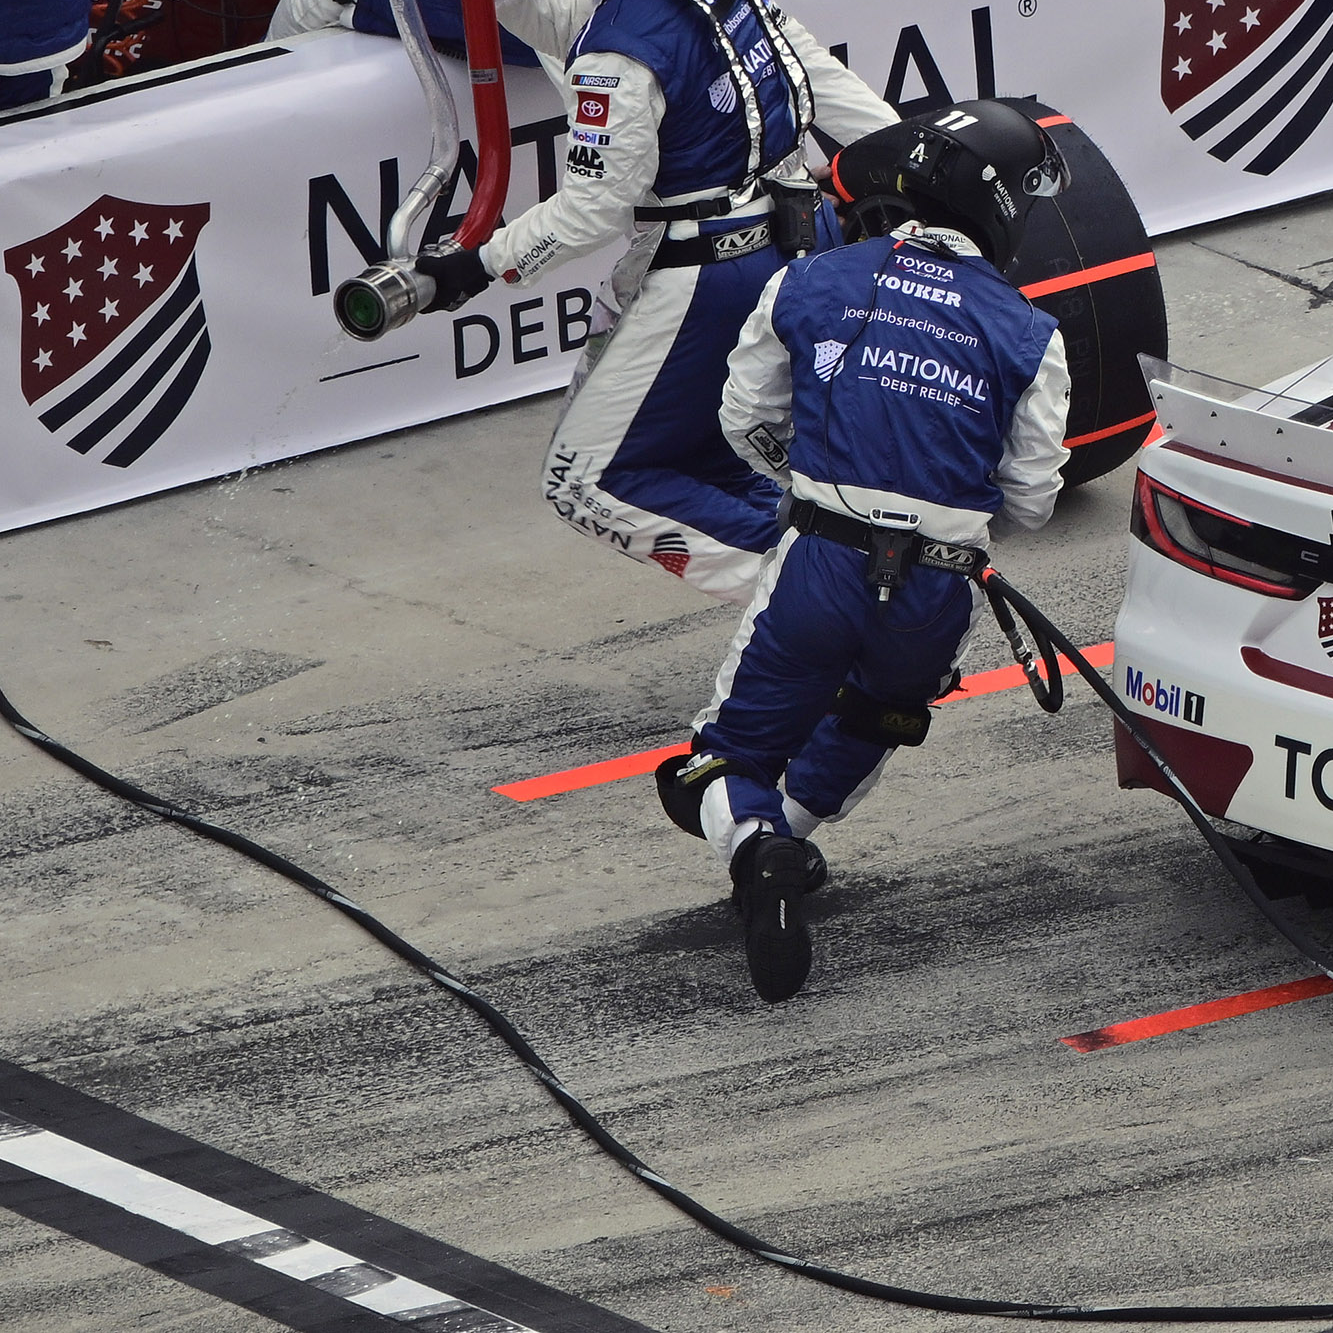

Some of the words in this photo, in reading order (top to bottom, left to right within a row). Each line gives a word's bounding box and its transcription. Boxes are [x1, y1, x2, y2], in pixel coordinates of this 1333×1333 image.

[583, 75, 619, 88] NASCAR
[572, 130, 598, 145] Mobil
[934, 109, 980, 132] 11
[566, 164, 605, 180] TOOLS
[567, 145, 605, 171] MAC
[993, 179, 1019, 219] NATIONAL
[516, 235, 557, 271] NATIONAL
[895, 254, 954, 280] TOYOTA
[872, 272, 962, 308] YOUKER
[452, 287, 594, 379] DEB
[841, 305, 979, 349] joegibbsracing.com
[861, 345, 987, 402] NATIONAL
[880, 377, 915, 398] DEBT
[919, 384, 963, 410] RELIEF
[1126, 666, 1181, 718] Mobil
